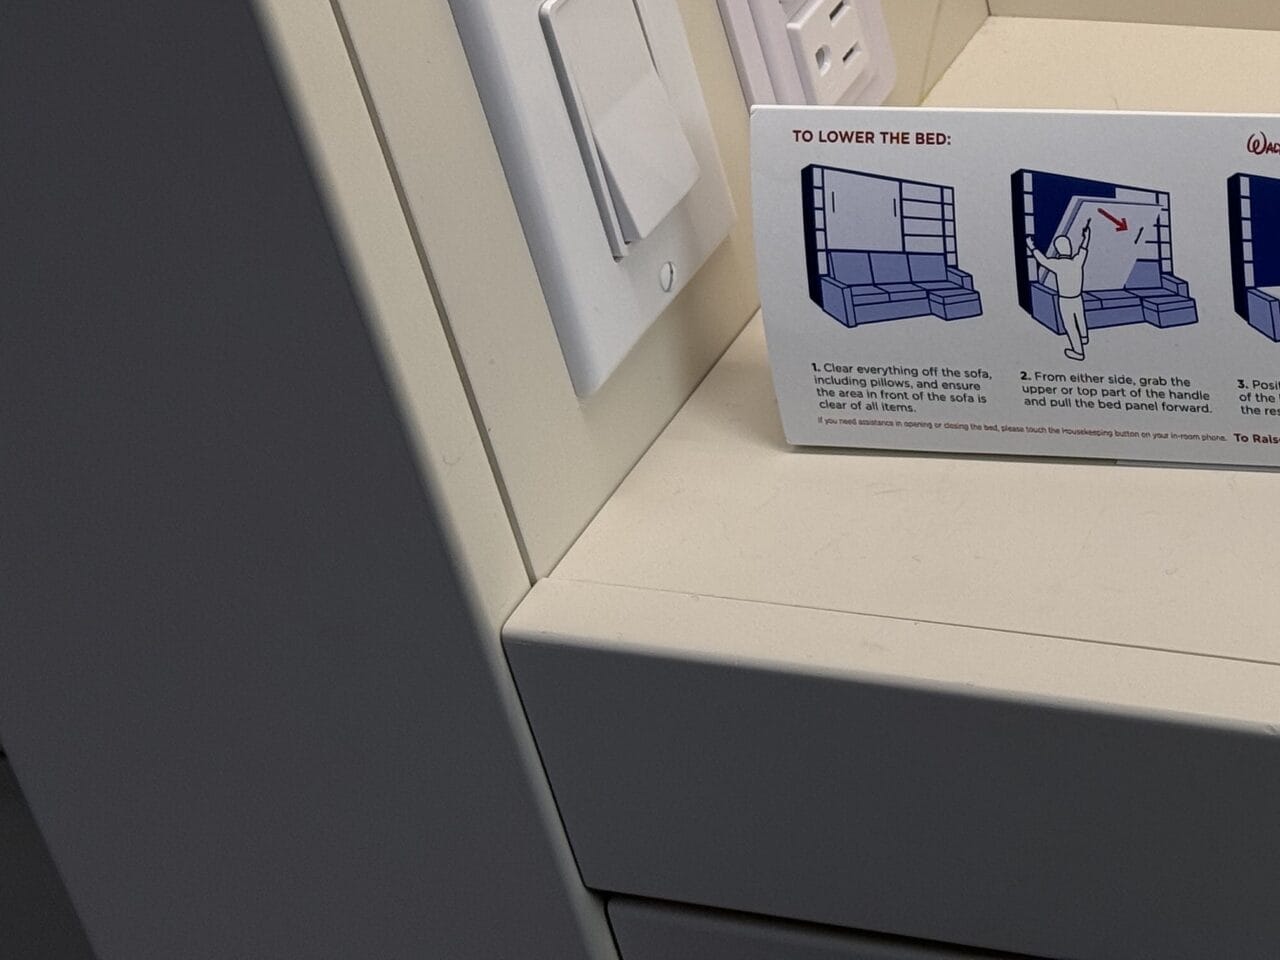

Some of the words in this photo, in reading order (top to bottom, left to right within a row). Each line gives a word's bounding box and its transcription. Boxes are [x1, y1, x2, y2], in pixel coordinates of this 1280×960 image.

[792, 130, 813, 143] TO
[819, 130, 875, 144] LOWER
[880, 132, 910, 144] THE
[915, 132, 951, 145] BED:
[812, 363, 821, 372] 1.
[823, 363, 853, 373] Clear
[857, 366, 918, 377] everything
[922, 367, 938, 377] off
[942, 368, 961, 378] the
[965, 369, 992, 380] sofa,
[814, 376, 867, 387] including
[871, 378, 913, 389] pillows,
[917, 380, 938, 389] and
[942, 382, 981, 390] ensure
[1020, 371, 1032, 381] 2.
[1035, 372, 1066, 382] From
[1070, 374, 1104, 383] either
[1108, 375, 1136, 386] side,
[1140, 376, 1167, 387] grab
[1171, 377, 1190, 387] the
[1237, 379, 1249, 389] 3.
[816, 388, 835, 397] the
[867, 391, 877, 399] in
[881, 391, 909, 400] front
[912, 391, 923, 401] of
[928, 392, 946, 402] the
[950, 393, 974, 403] sofa
[978, 394, 987, 403] is
[1022, 386, 1057, 394] upper
[1061, 387, 1073, 395] or
[1078, 387, 1097, 397] top
[1102, 388, 1125, 397] part
[1130, 388, 1142, 397] of
[1146, 390, 1165, 399] the
[1169, 390, 1210, 400] handle
[1239, 393, 1251, 402] of
[1255, 393, 1276, 403] the
[819, 400, 847, 409] clear
[851, 401, 861, 410] of
[866, 402, 878, 411] all
[882, 402, 917, 412] items.
[1024, 397, 1046, 406] and
[1050, 398, 1071, 408] pull
[1075, 399, 1095, 408] the
[1099, 400, 1122, 409] bed
[1126, 401, 1158, 411] panel
[1162, 402, 1212, 413] forward.
[1240, 406, 1261, 415] the
[1026, 426, 1046, 434] touch
[1048, 426, 1060, 434] the
[1114, 430, 1140, 438] button
[1234, 433, 1249, 443] To
